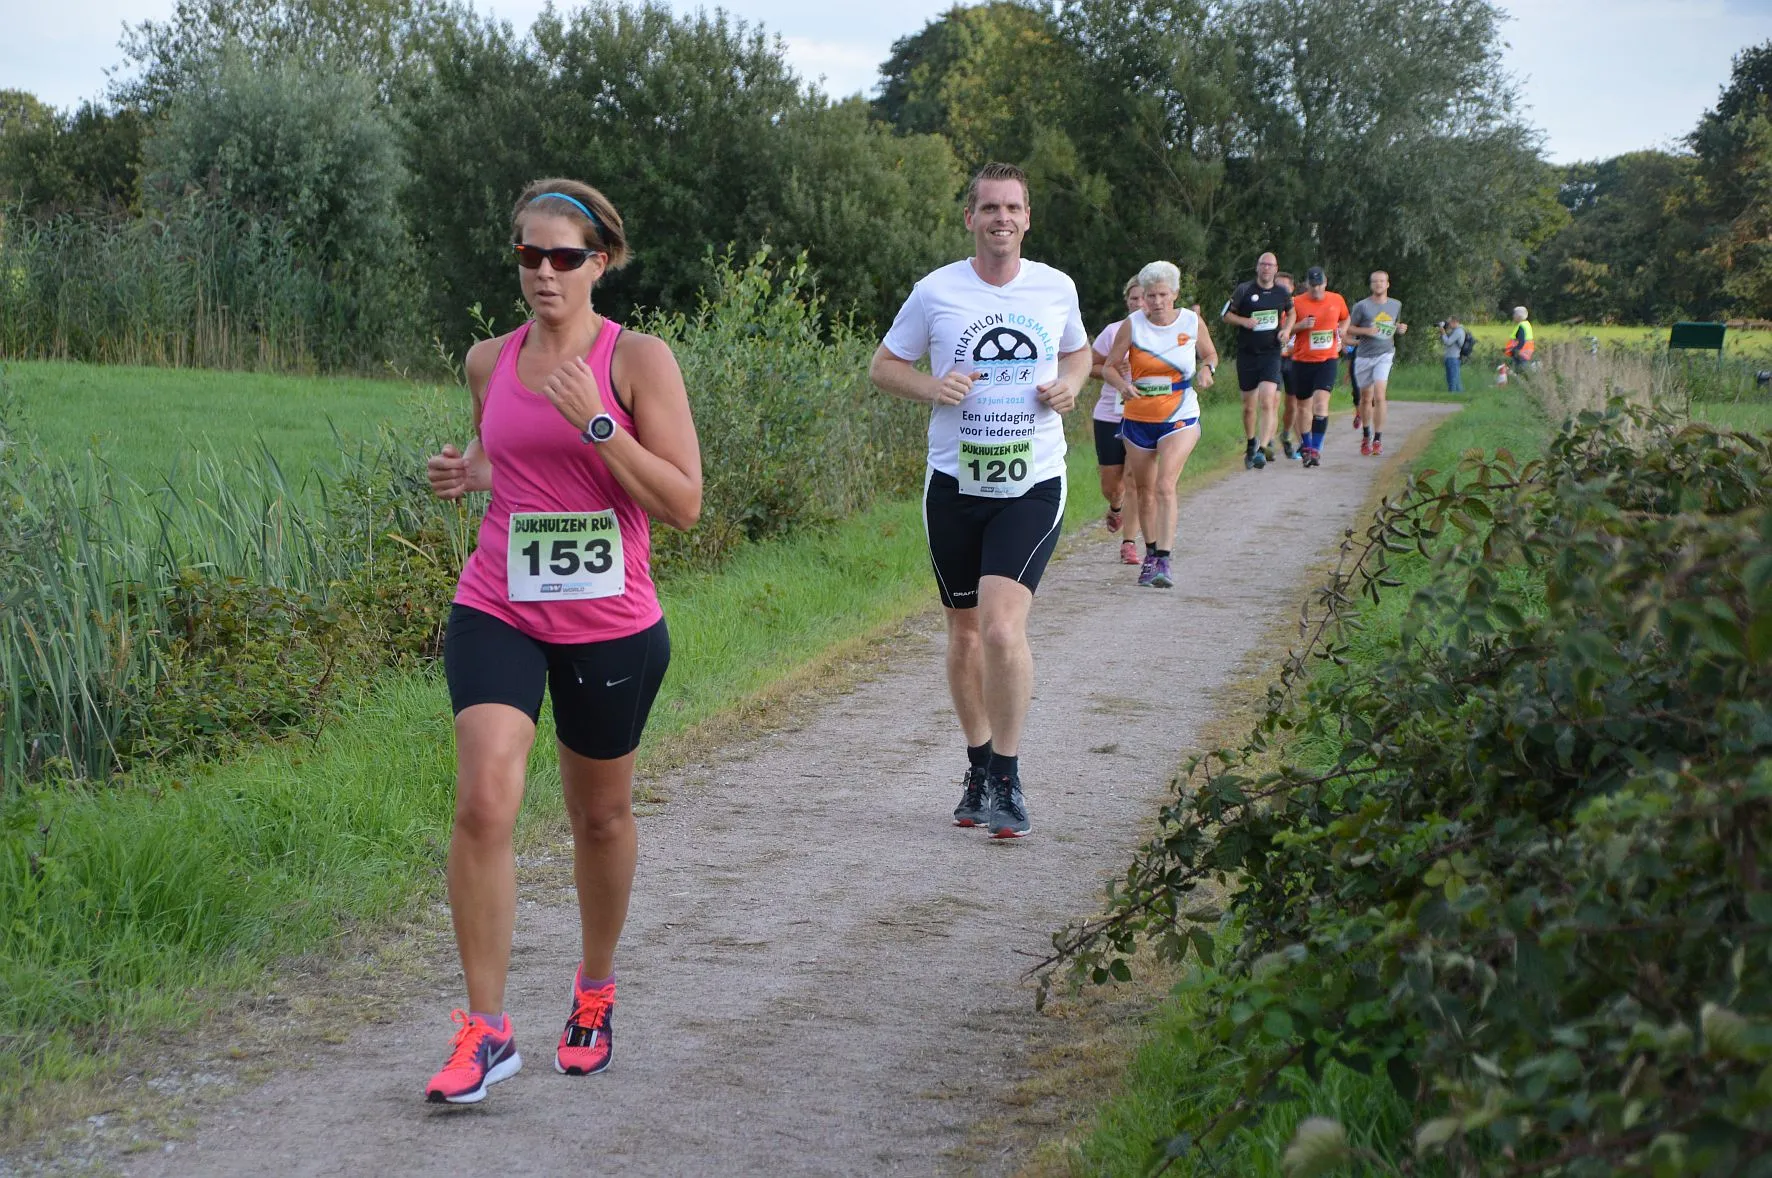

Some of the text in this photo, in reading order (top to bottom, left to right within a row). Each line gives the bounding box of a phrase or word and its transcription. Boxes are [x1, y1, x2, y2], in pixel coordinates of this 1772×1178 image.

[954, 312, 1054, 364] TRIATHLON ROSMALEN
[987, 396, 1004, 406] juni
[962, 410, 1036, 424] Een uitdaging
[960, 425, 1036, 437] voor iedereen!
[1013, 441, 1030, 454] RUN
[967, 458, 1028, 483] 120
[522, 538, 613, 576] 153
